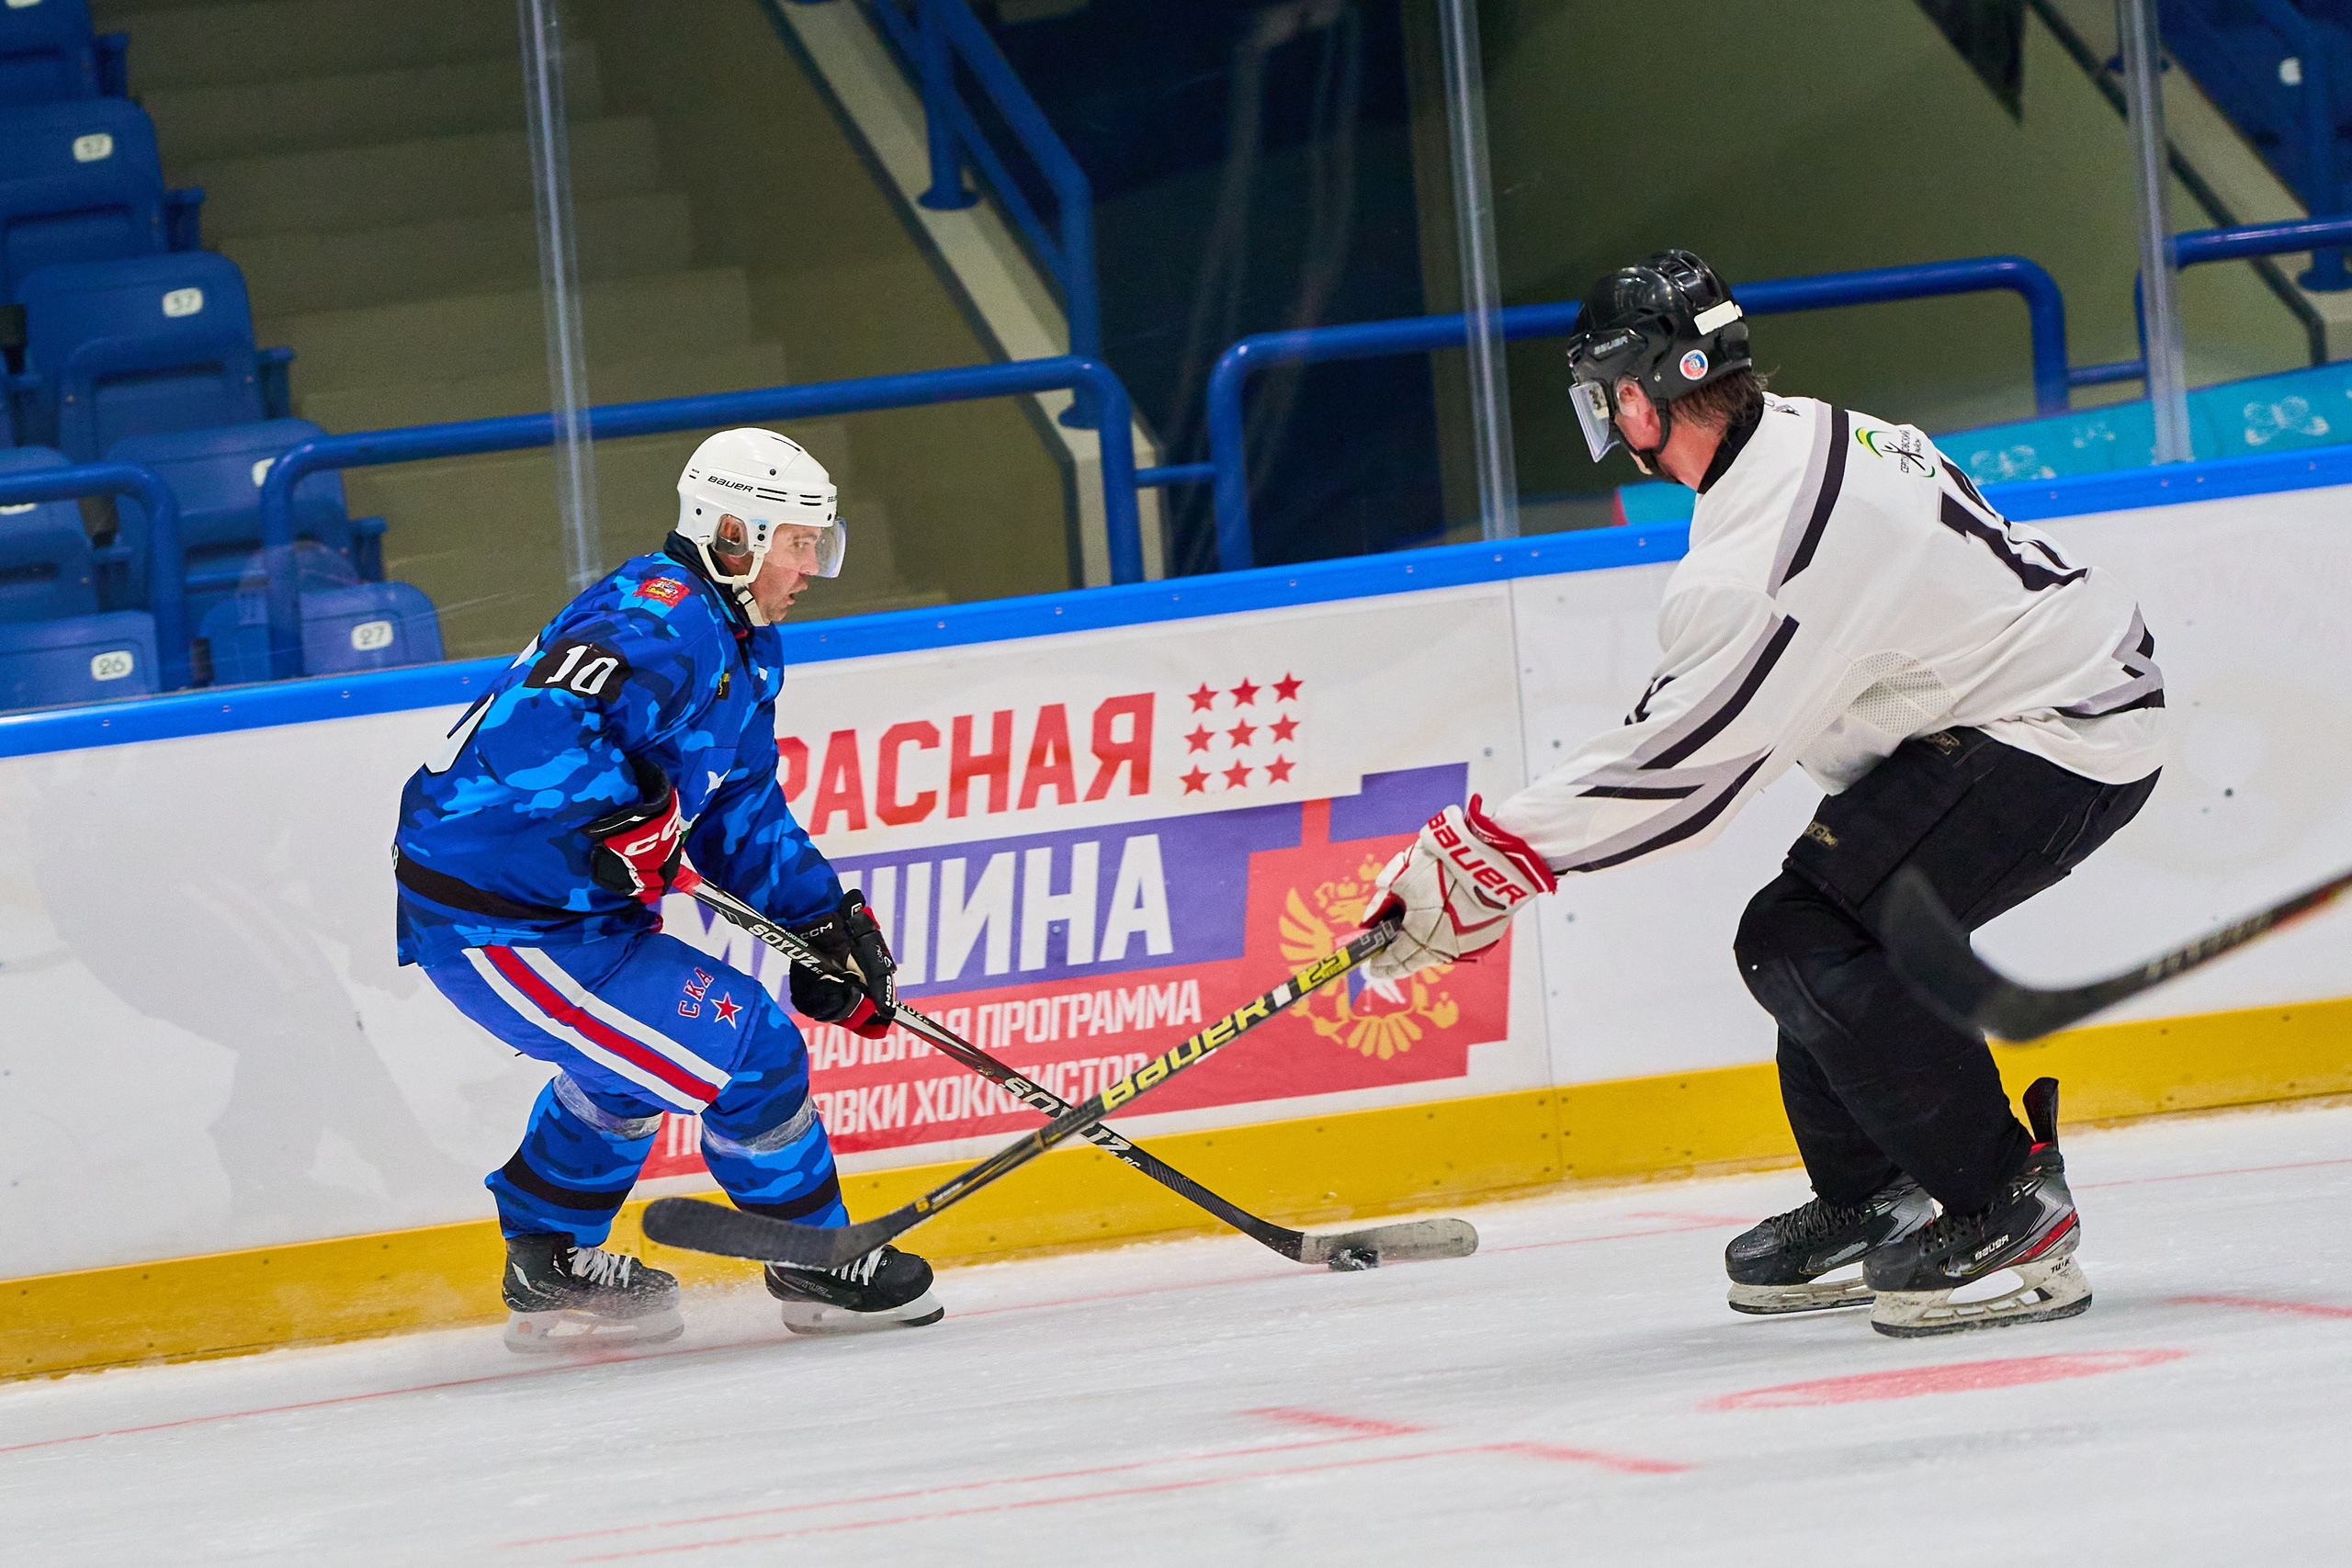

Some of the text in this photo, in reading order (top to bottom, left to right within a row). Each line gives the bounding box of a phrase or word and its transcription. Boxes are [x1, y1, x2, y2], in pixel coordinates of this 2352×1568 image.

[707, 475, 753, 492] BAUER
[361, 626, 385, 644] 27
[545, 645, 619, 694] 10
[775, 693, 1156, 836] РАСНАЯ
[624, 809, 681, 856] CC
[1427, 811, 1528, 905] BAUER
[748, 923, 821, 968] SOYUZ
[799, 922, 833, 940] CCM
[678, 966, 715, 1019] СКА
[978, 978, 1202, 1050] ПРОГРАММА
[1102, 996, 1270, 1111] BAUER
[1974, 1234, 2009, 1261] BAUER
